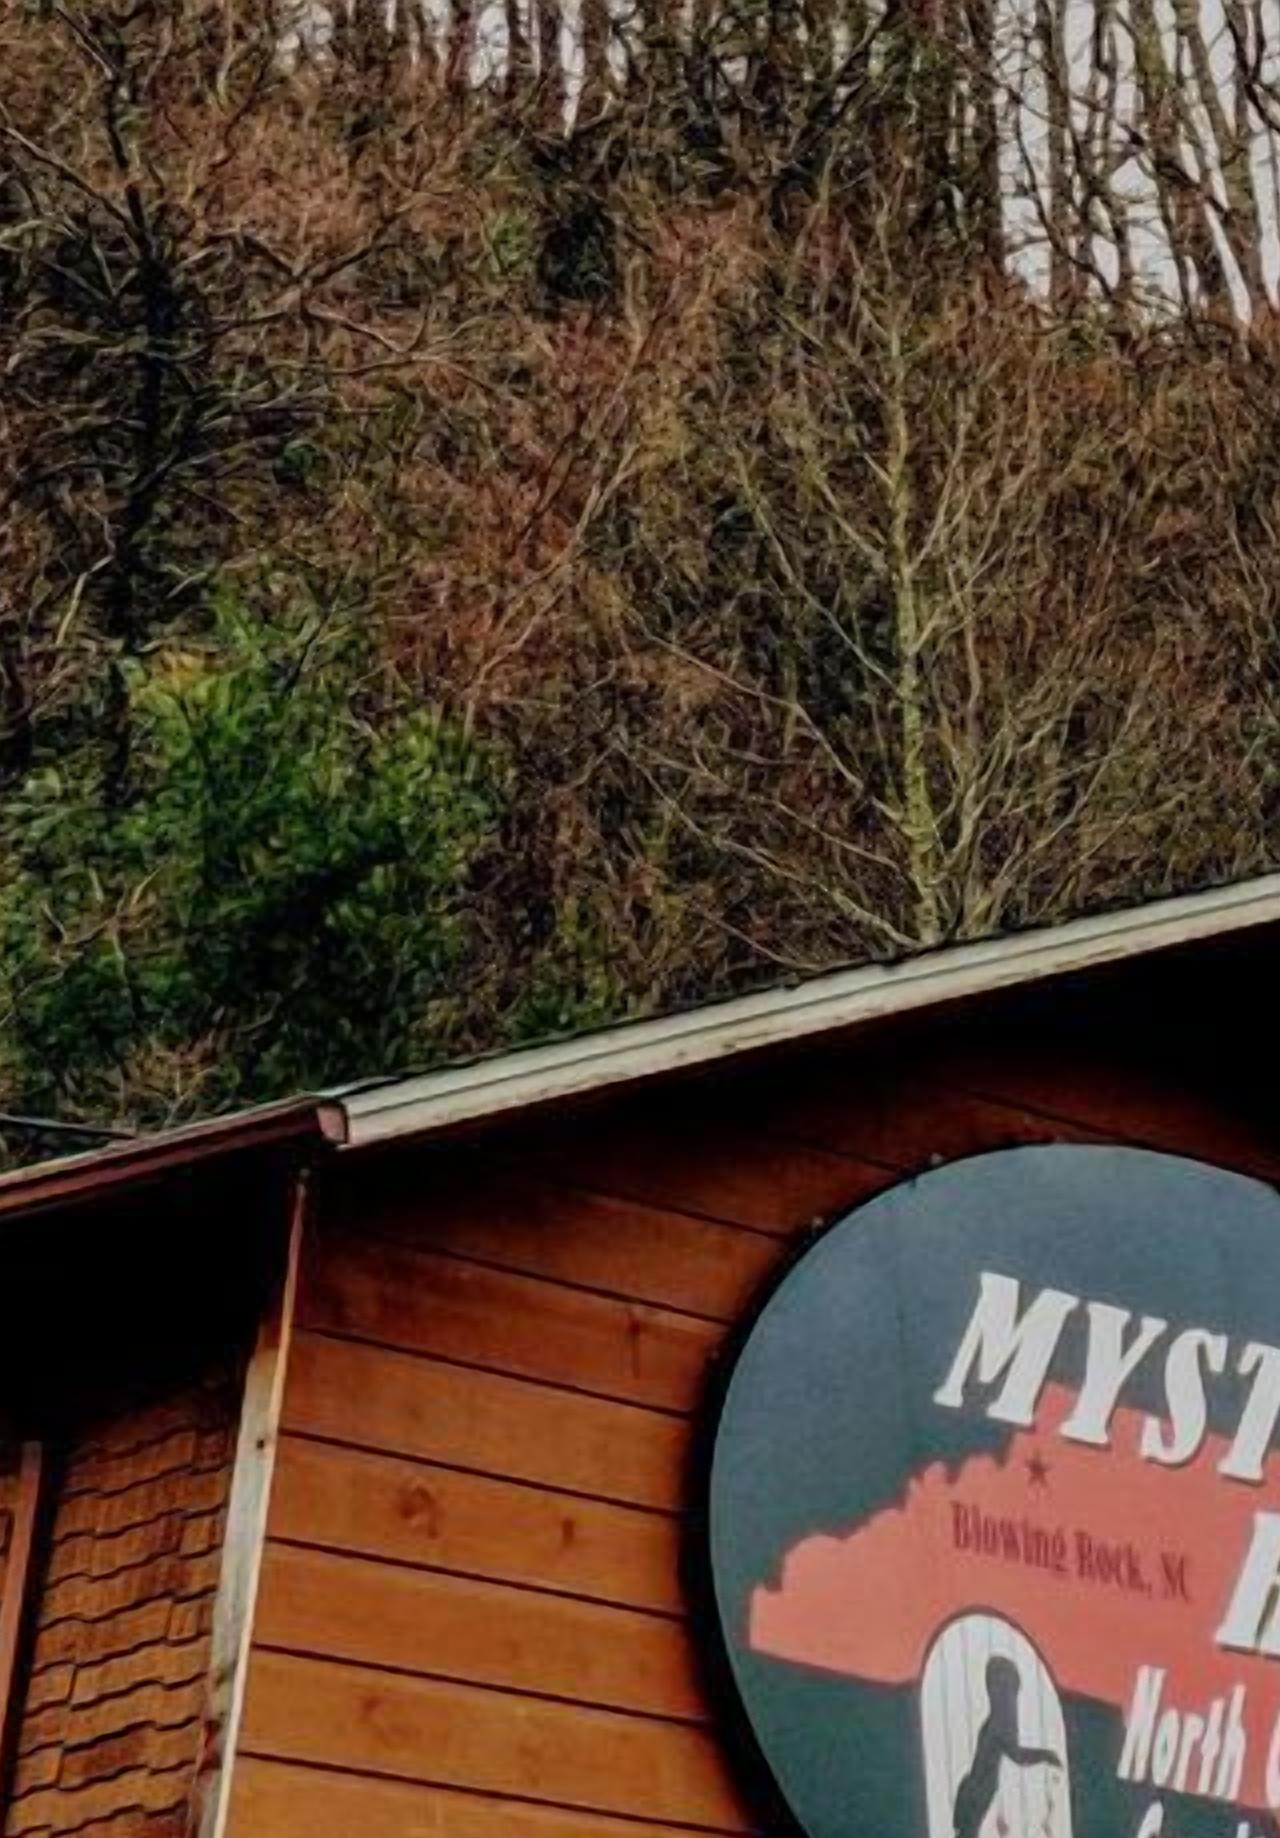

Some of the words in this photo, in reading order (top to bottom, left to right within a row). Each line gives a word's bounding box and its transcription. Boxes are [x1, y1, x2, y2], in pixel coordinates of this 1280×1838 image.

[951, 1500, 1068, 1573] Blowing
[1074, 1530, 1153, 1597] Rock,
[1116, 1664, 1247, 1800] North
